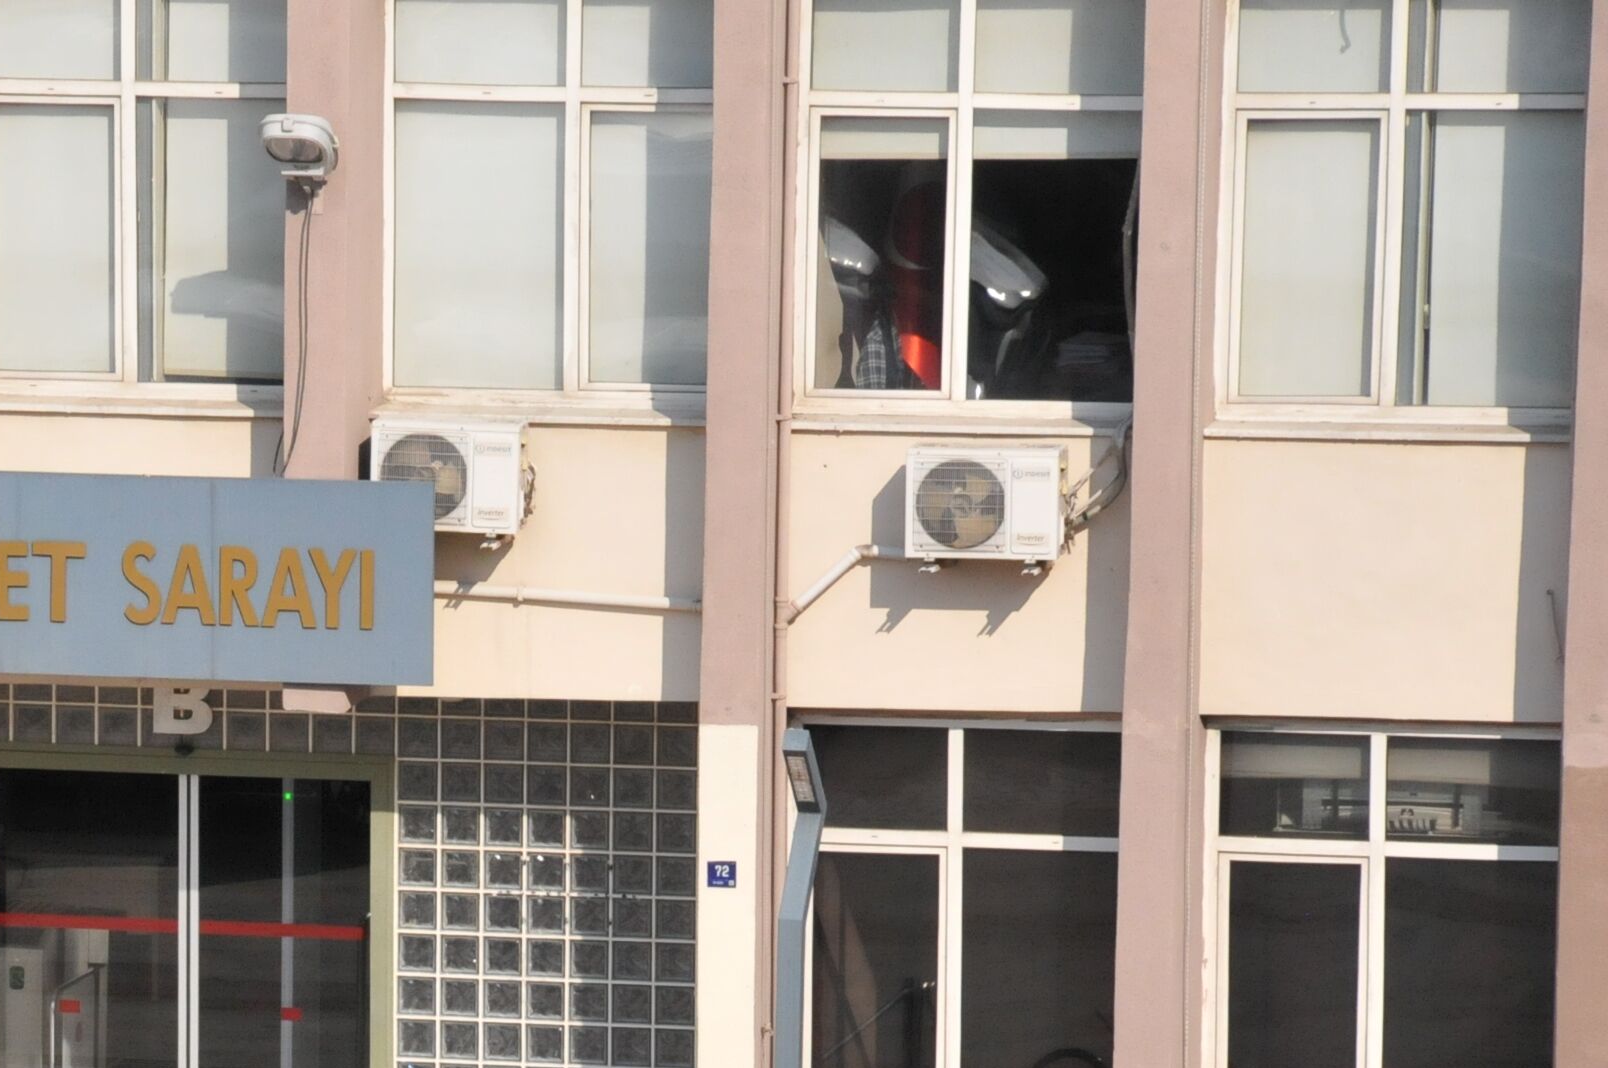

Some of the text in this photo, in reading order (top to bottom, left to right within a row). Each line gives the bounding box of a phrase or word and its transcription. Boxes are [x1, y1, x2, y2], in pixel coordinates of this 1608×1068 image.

[121, 540, 375, 631] SARAYI
[153, 687, 213, 735] B
[714, 864, 730, 878] 72
